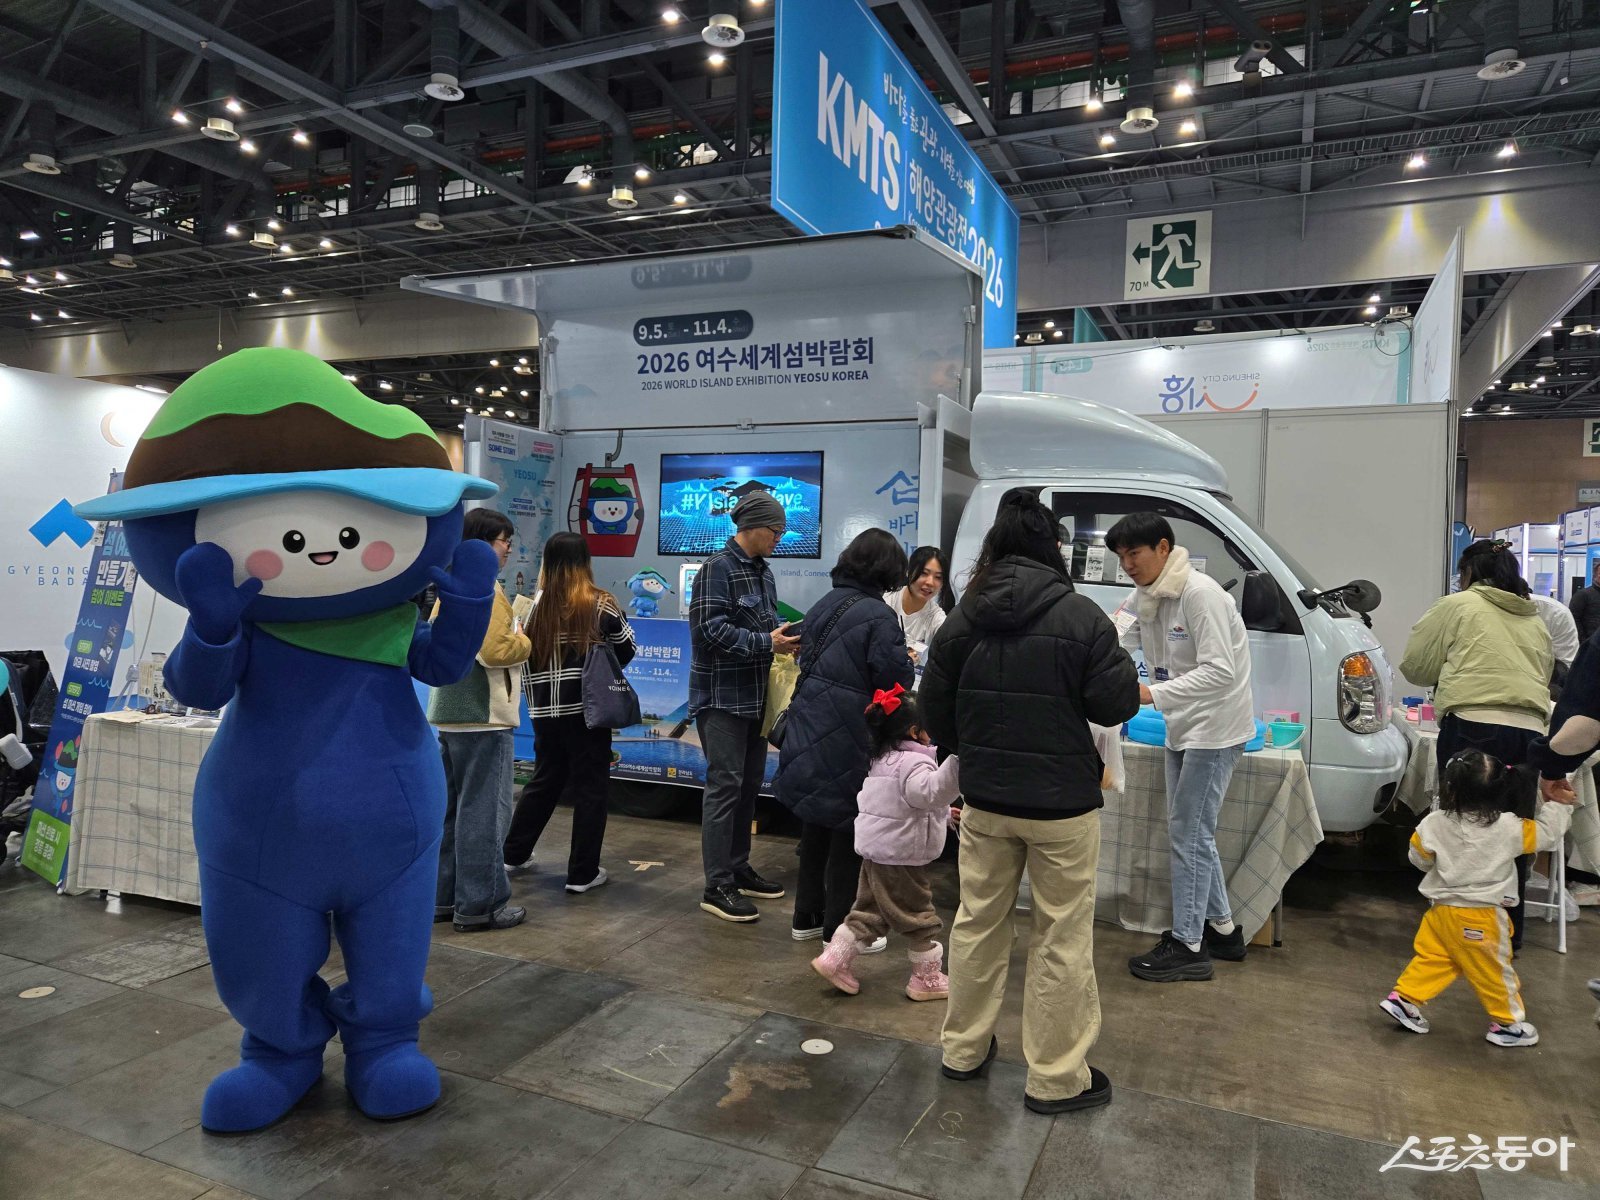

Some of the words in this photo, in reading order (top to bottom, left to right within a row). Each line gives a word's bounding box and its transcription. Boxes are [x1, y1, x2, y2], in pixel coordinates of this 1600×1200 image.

[817, 51, 900, 211] KMTS
[638, 323, 668, 340] 9.5.
[693, 318, 732, 336] 11.4.
[637, 352, 690, 375] 2026
[696, 337, 874, 374] 여수세계섬박람회
[641, 380, 663, 391] 2026
[664, 379, 698, 390] WORLD
[700, 377, 733, 388] ISLAND
[736, 374, 792, 387] EXHIBITION
[794, 372, 829, 384] YEOSU
[832, 370, 869, 382] KOREA
[514, 469, 537, 480] YEOSU
[708, 492, 740, 511] Isla
[8, 566, 89, 575] GYEONG
[95, 560, 128, 587] 만들기
